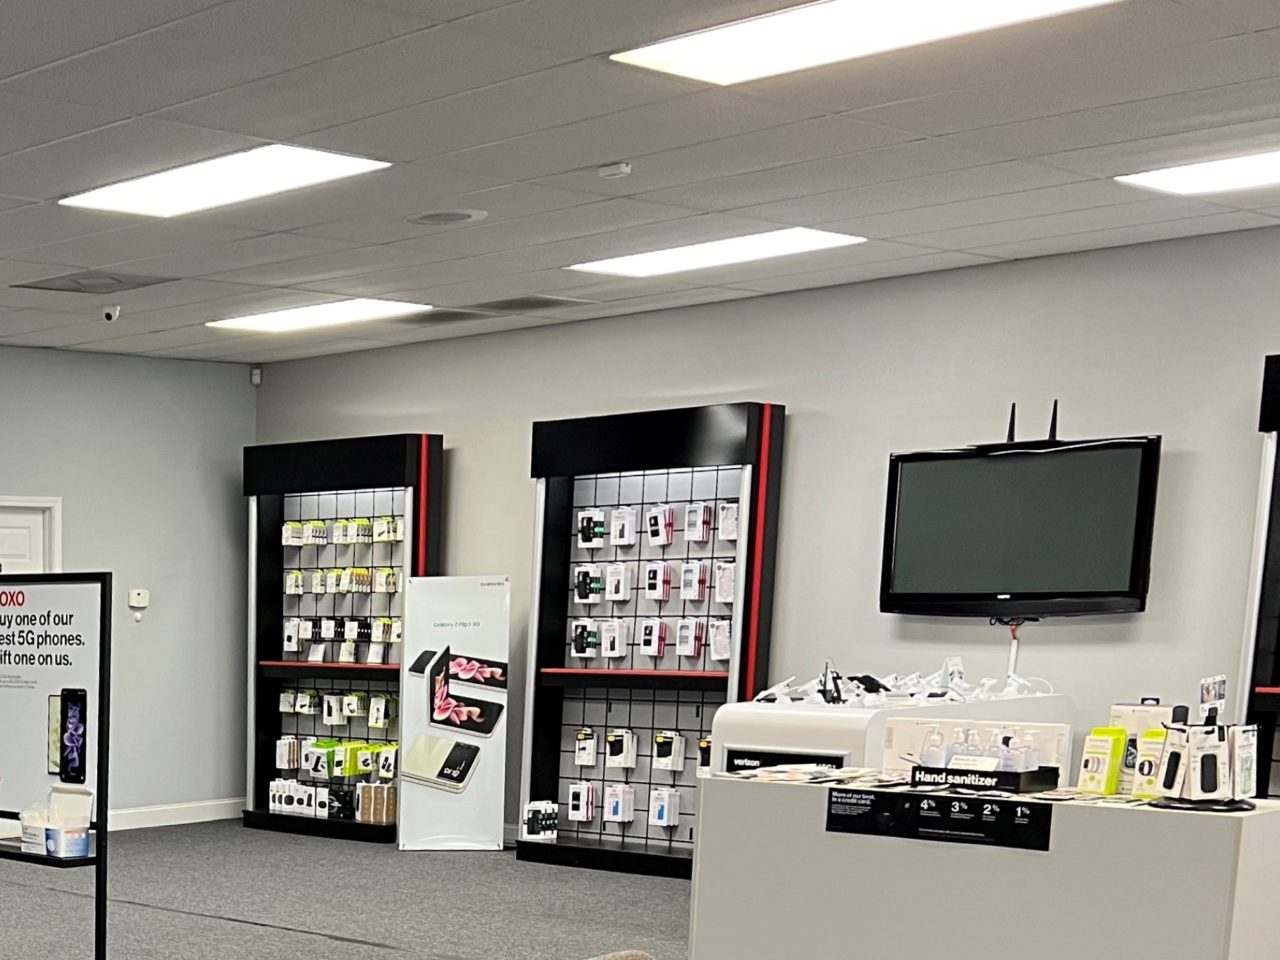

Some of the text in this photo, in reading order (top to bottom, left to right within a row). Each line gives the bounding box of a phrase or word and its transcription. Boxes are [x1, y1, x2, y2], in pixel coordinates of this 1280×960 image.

[15, 614, 37, 626] one
[39, 610, 51, 626] of
[53, 614, 74, 626] our
[17, 629, 35, 646] 5G
[37, 630, 85, 649] phones.
[14, 653, 36, 665] one
[37, 653, 53, 665] on
[54, 654, 72, 666] us.
[733, 758, 760, 767] verizon
[915, 770, 998, 787] Hand sanitizer
[920, 799, 1031, 817] 4% 3% 2% 1%
